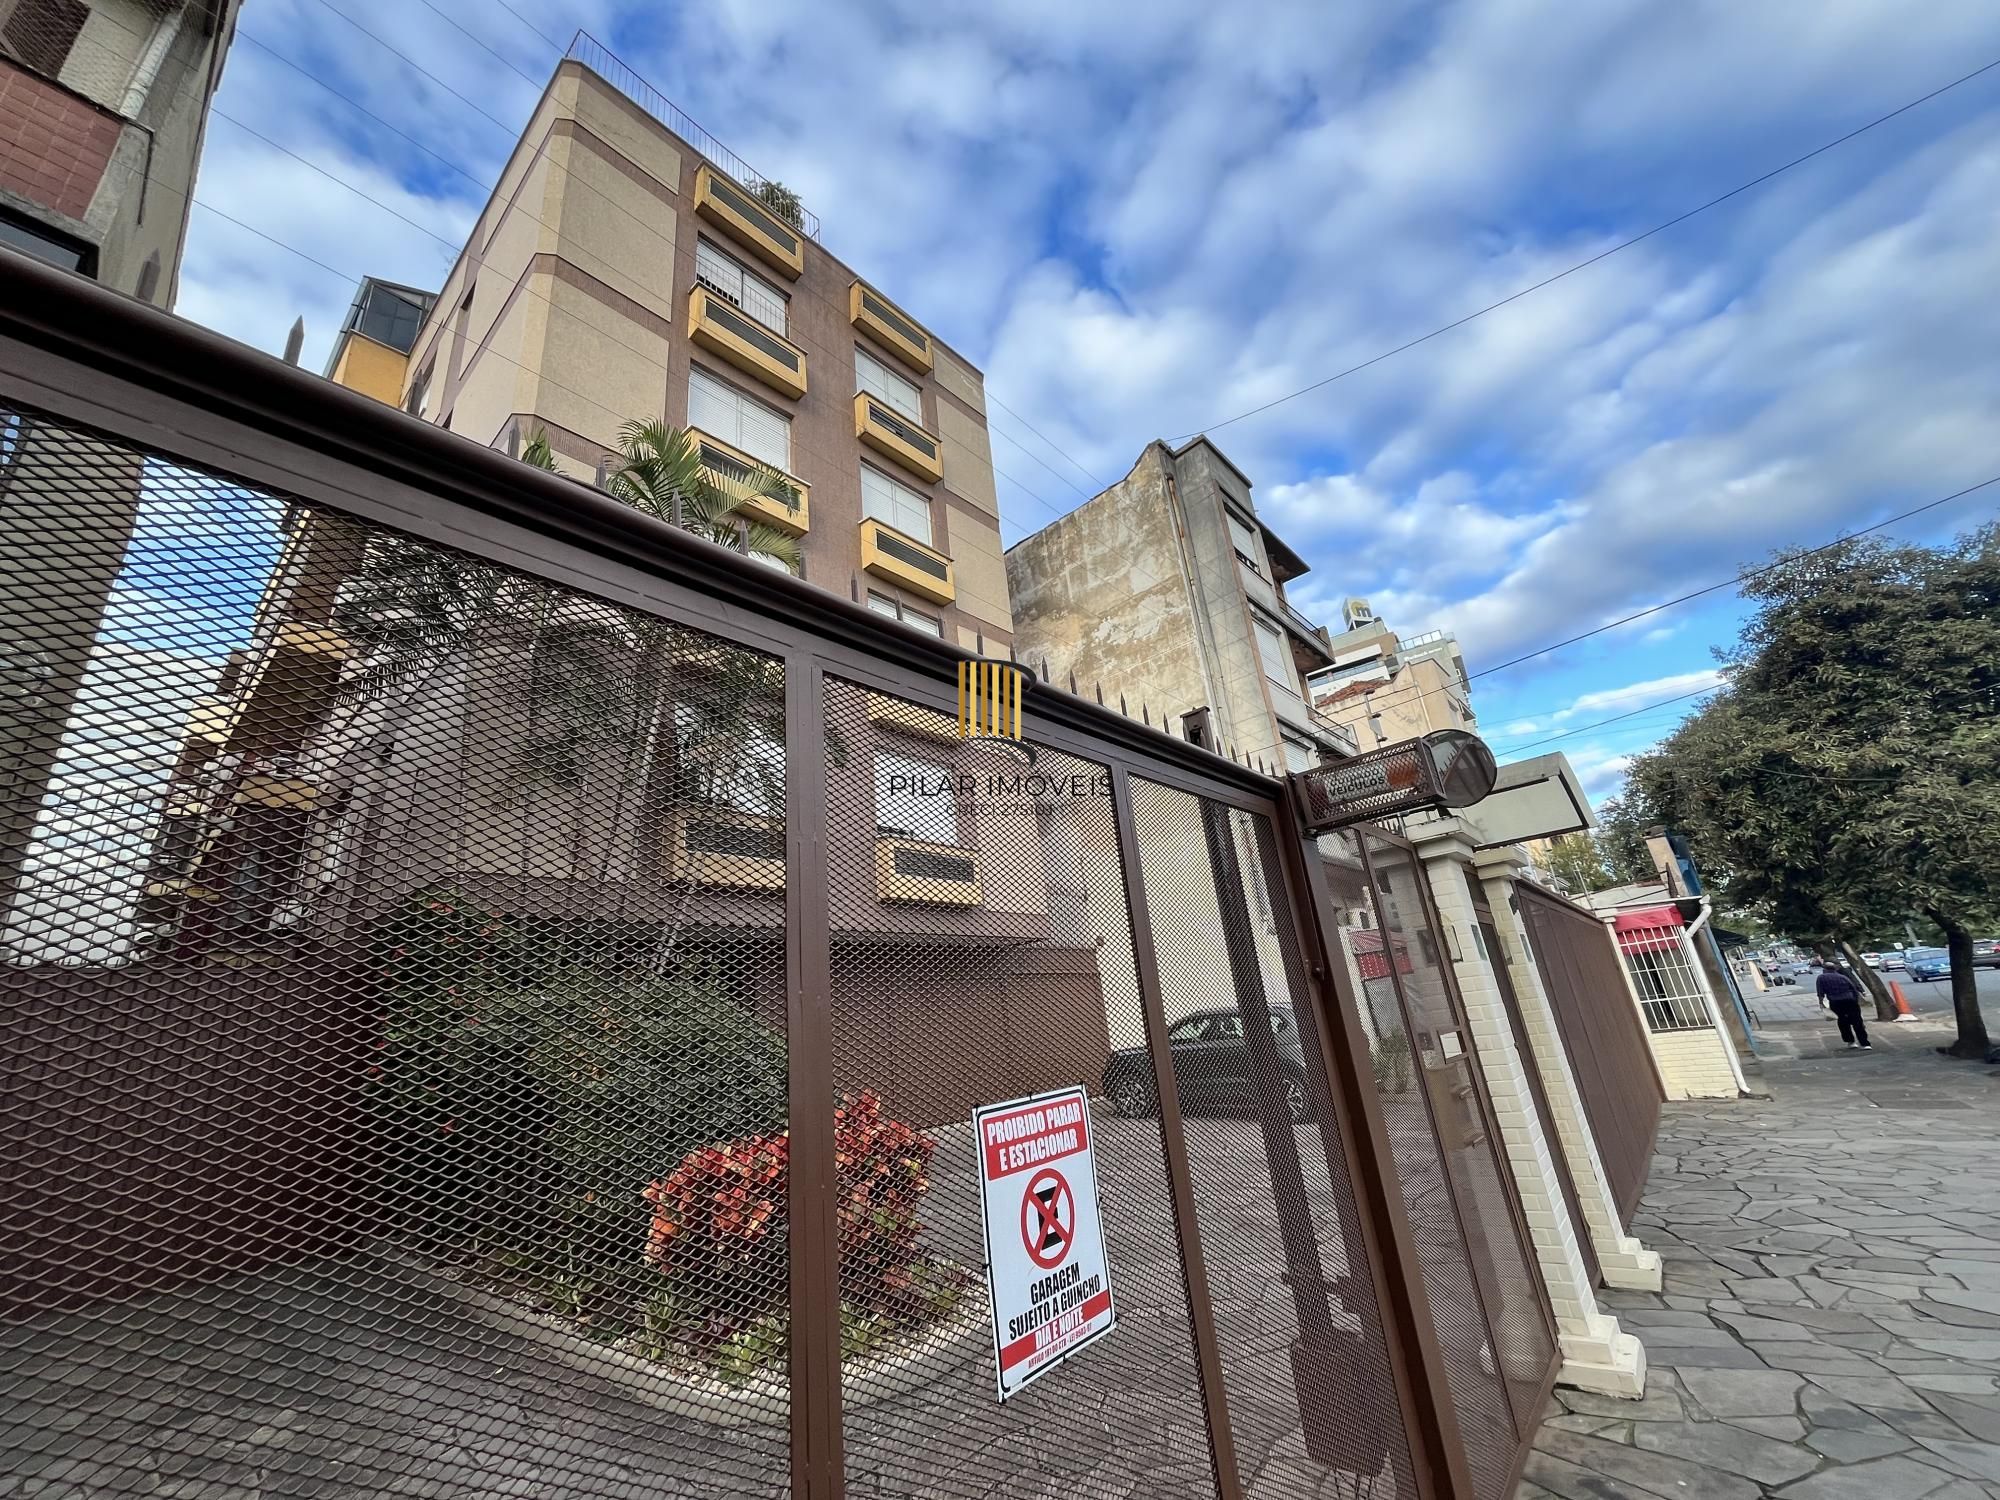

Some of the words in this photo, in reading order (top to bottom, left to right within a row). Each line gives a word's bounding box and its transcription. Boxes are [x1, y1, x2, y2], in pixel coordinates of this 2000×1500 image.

[986, 1110, 1046, 1146] PROIBIDO
[1045, 1102, 1082, 1130] PARAR
[999, 1148, 1008, 1171] E
[1008, 1128, 1078, 1169] ESTACIONAR
[1030, 1260, 1081, 1306] GARAGEM
[1008, 1302, 1050, 1341] SUJEITO
[1052, 1296, 1060, 1317] A
[1060, 1273, 1101, 1313] GUINCHO
[1035, 1323, 1053, 1350] DIA
[1051, 1319, 1059, 1341] E
[1058, 1305, 1085, 1338] NOITE
